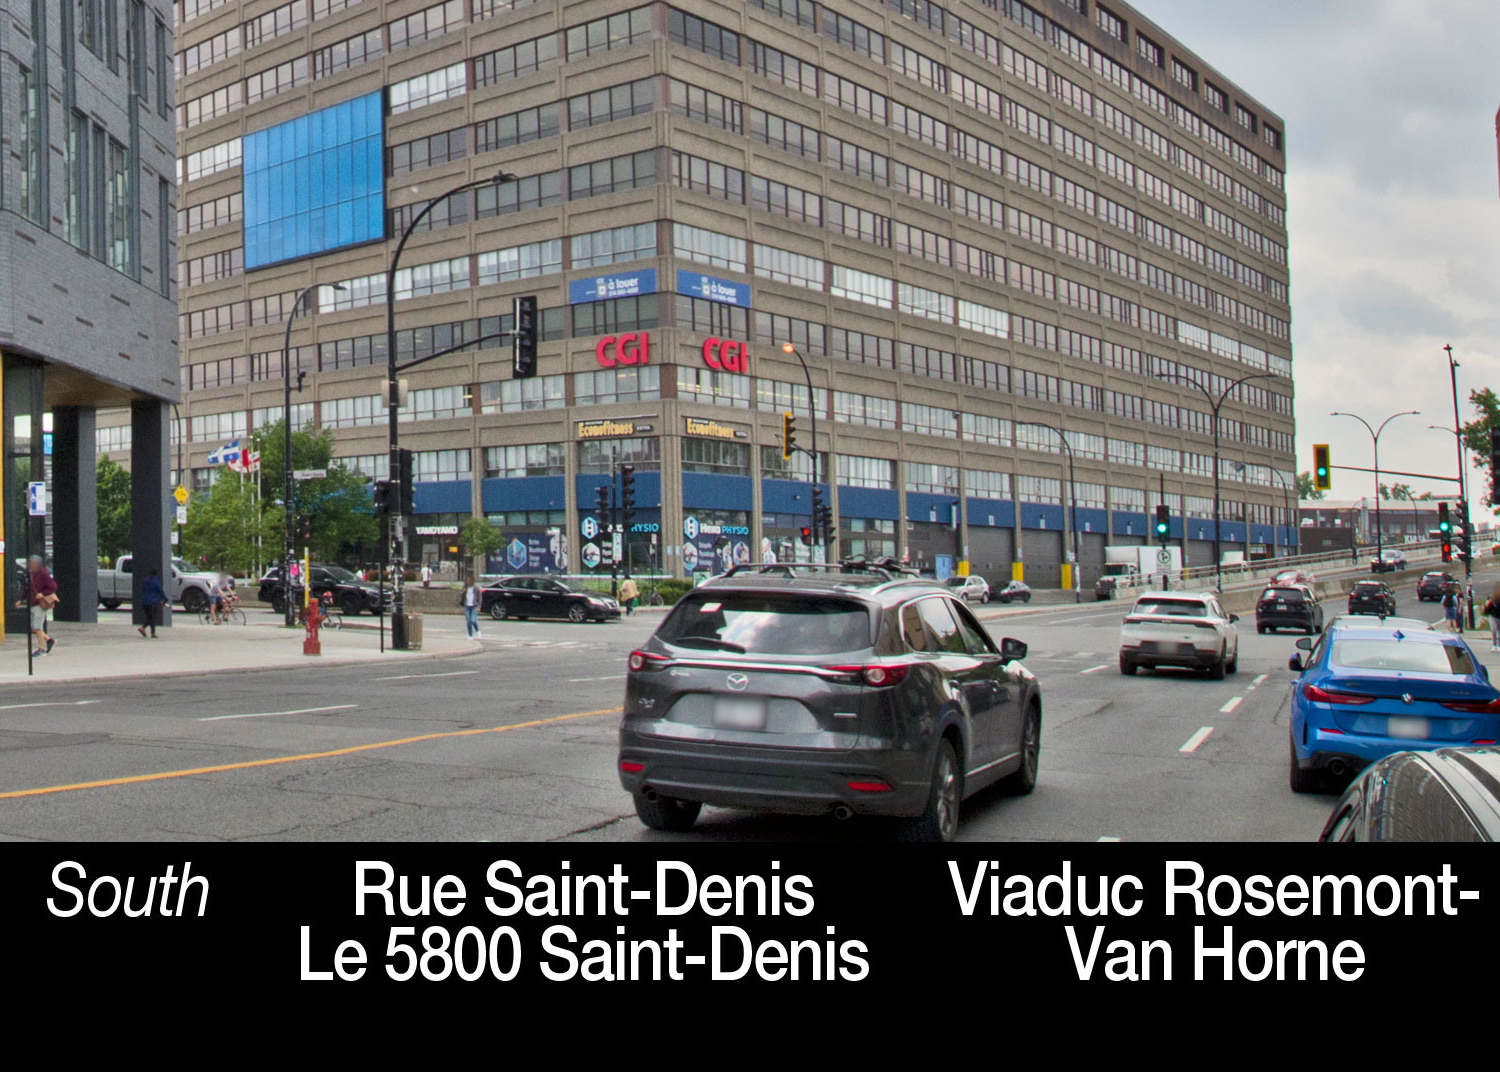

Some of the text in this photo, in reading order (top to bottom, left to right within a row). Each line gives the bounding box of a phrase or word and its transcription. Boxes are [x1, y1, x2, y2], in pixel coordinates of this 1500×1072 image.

[608, 280, 615, 289] à
[616, 278, 639, 289] louer
[711, 281, 717, 292] à
[717, 282, 737, 296] louer
[595, 332, 649, 368] CGI
[702, 337, 747, 373] CGI
[722, 525, 749, 535] PHYSIO
